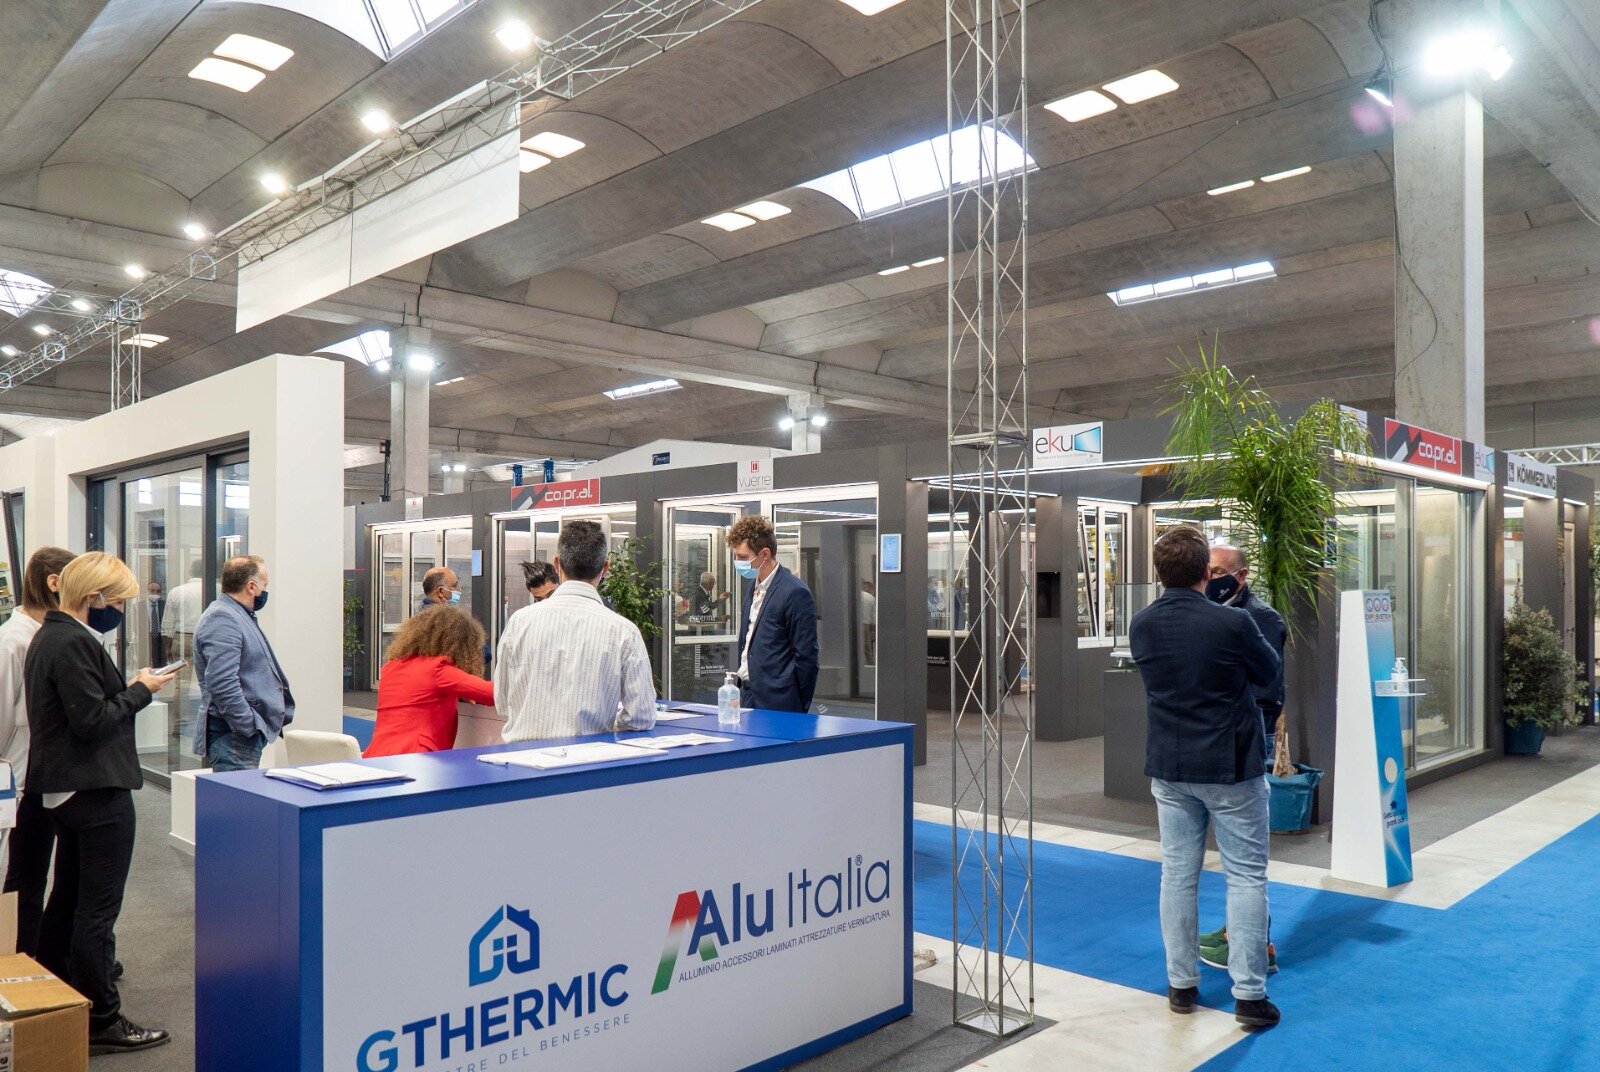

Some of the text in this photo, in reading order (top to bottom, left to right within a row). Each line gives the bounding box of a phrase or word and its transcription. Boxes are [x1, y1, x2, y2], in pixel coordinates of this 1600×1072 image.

[1035, 428, 1074, 454] eku
[738, 475, 771, 488] vuerre
[1516, 463, 1556, 490] KÖMMERLING
[544, 485, 593, 503] co.pr.al.
[678, 909, 891, 983] ALLUMINIO ACCESSORI LAMINATI ATTREZZATURE VERNICIATURA
[356, 963, 630, 1072] GTHERMIC
[498, 1049, 530, 1065] DEL
[540, 1013, 631, 1051] BENESSERE
